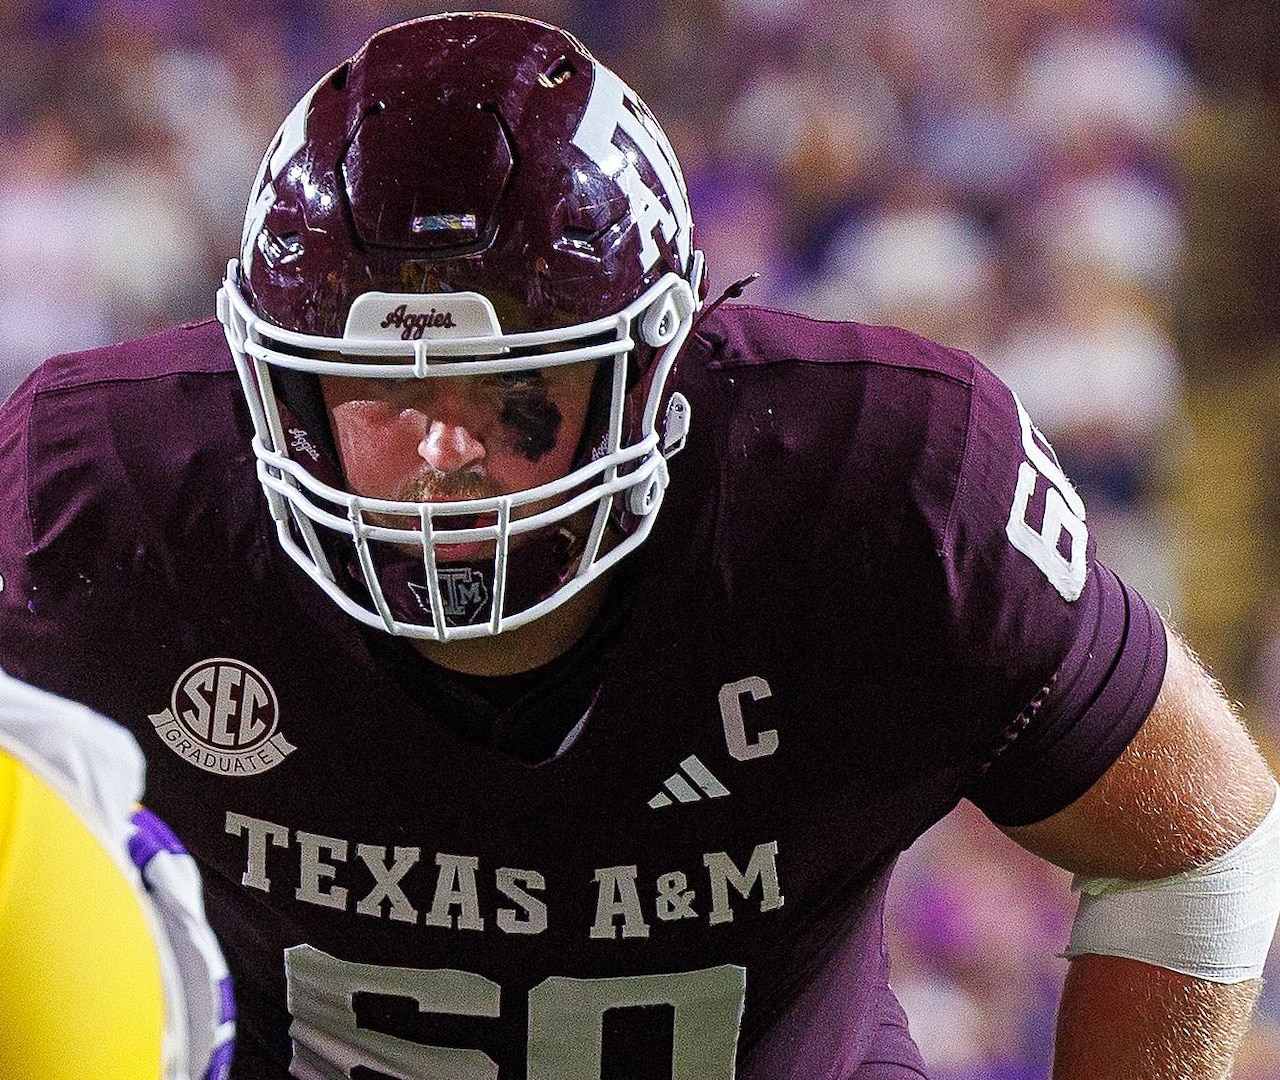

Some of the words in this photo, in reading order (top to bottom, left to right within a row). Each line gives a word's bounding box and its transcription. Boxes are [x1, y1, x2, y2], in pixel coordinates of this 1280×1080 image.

[380, 304, 457, 340] Aggies
[182, 666, 269, 746] SEC
[718, 676, 779, 761] C
[165, 728, 274, 772] GRADUATE
[224, 811, 549, 935] TEXAS
[589, 841, 785, 940] A&M
